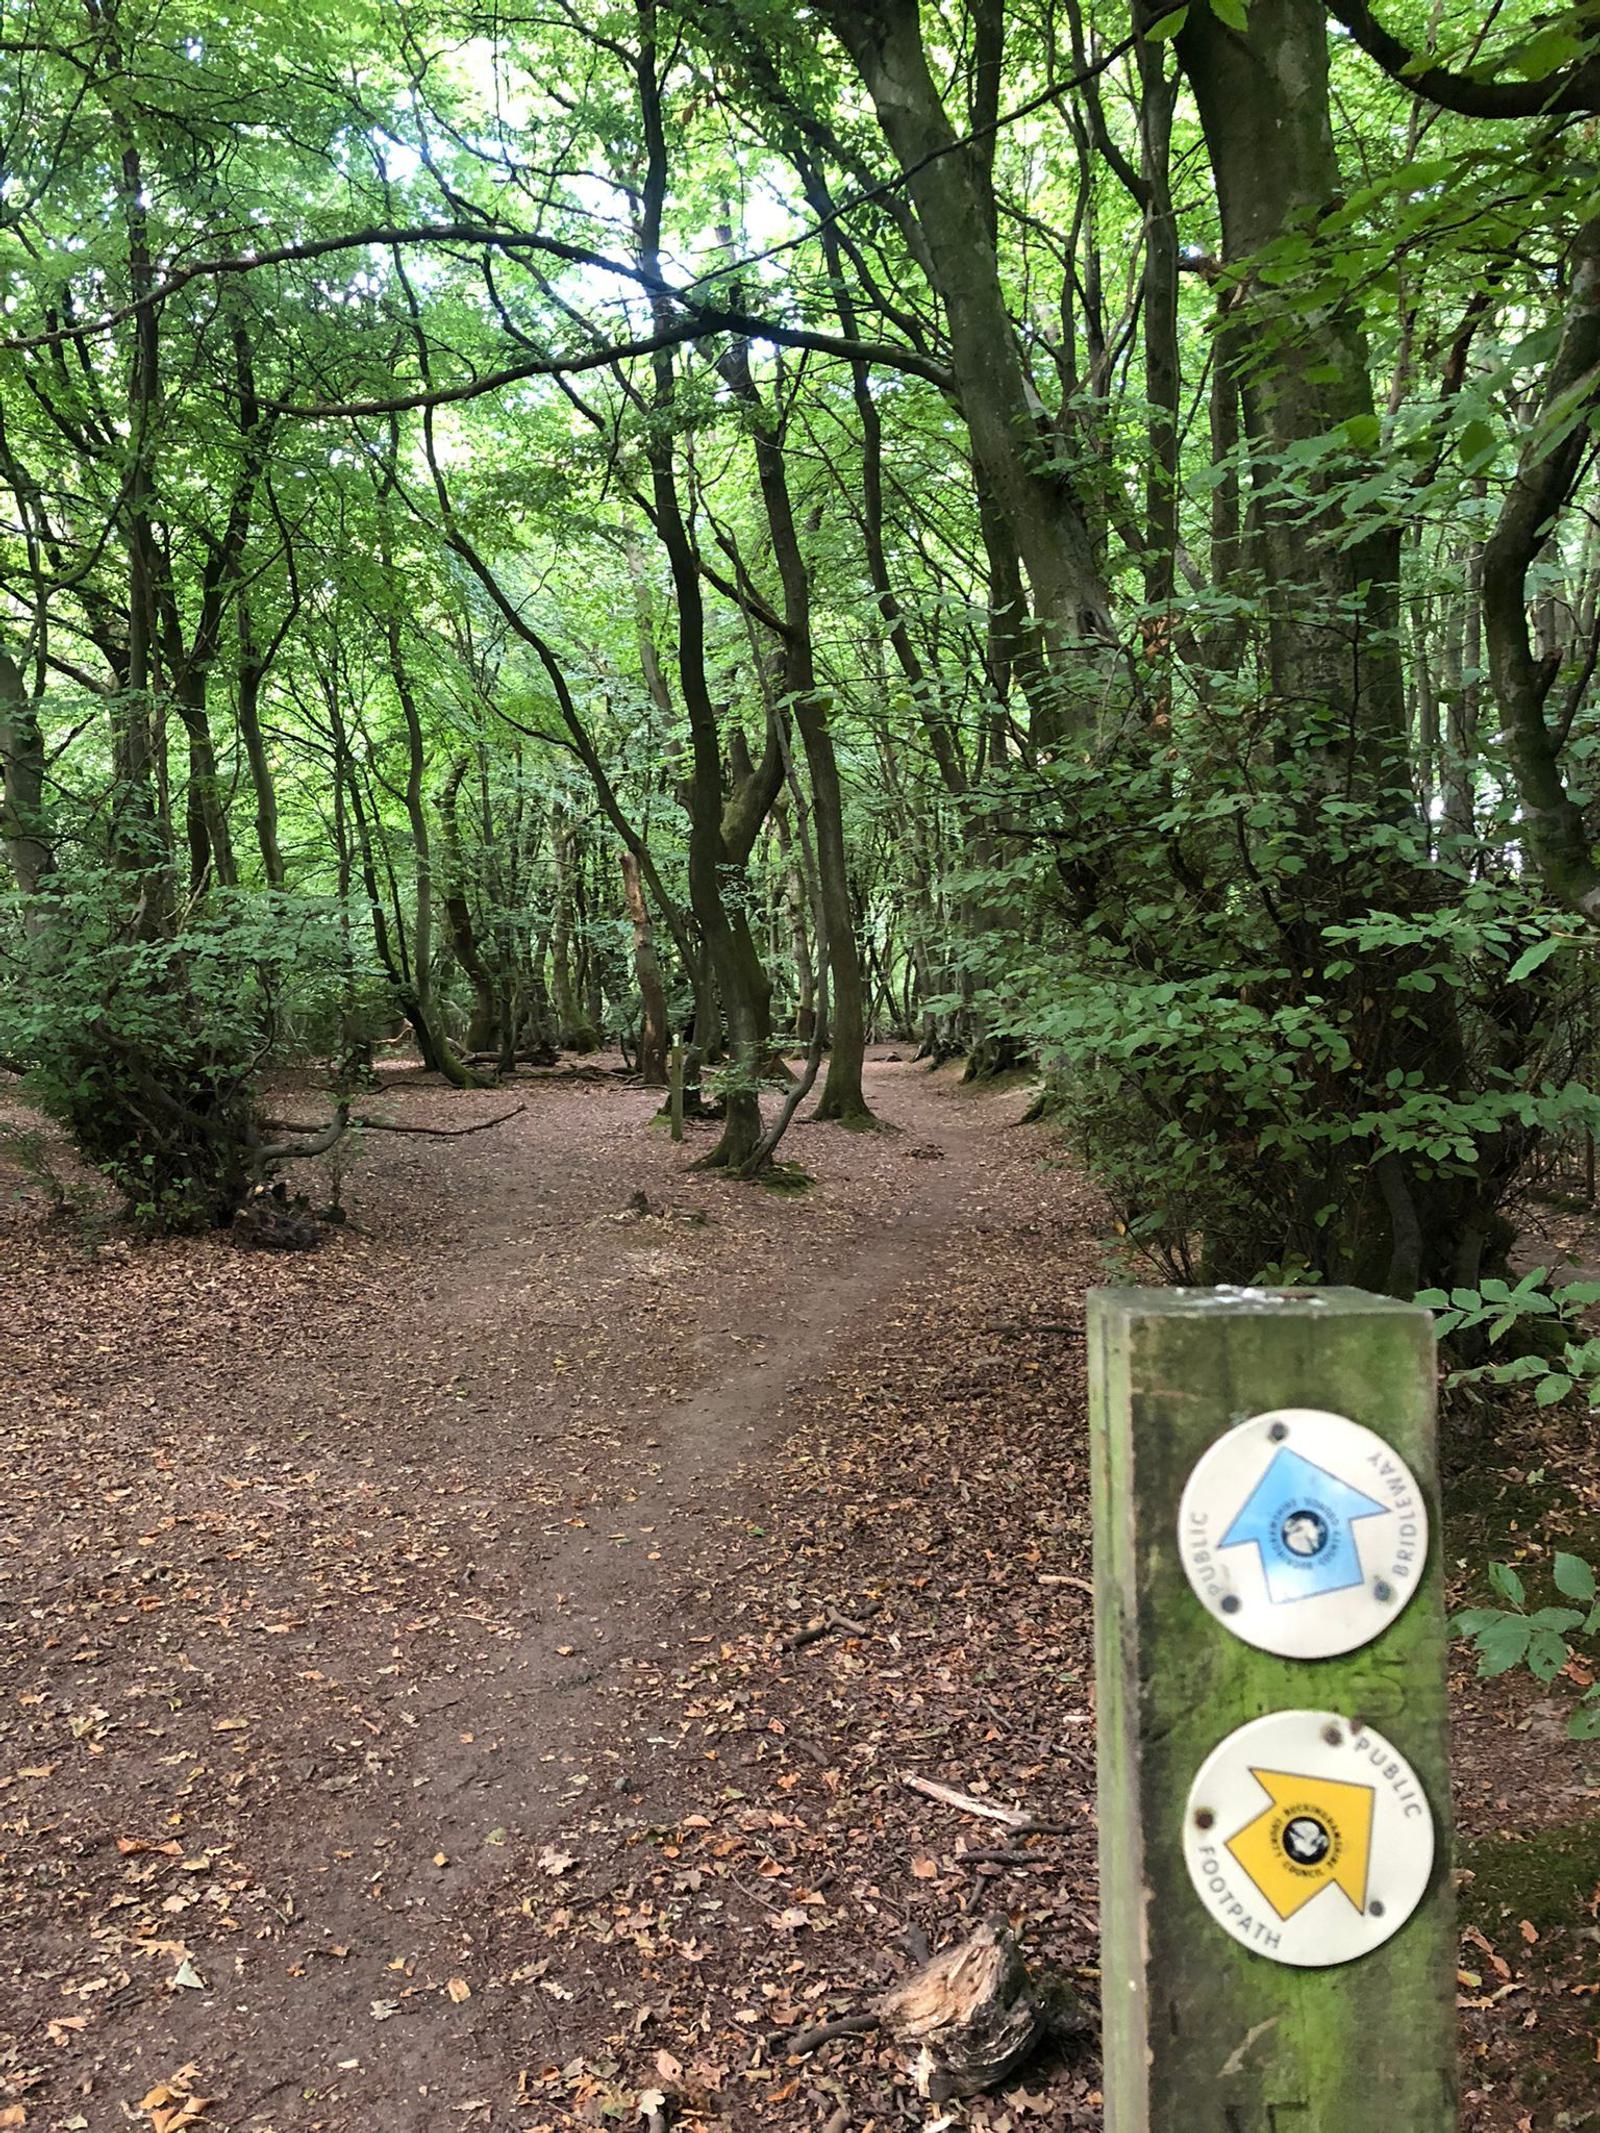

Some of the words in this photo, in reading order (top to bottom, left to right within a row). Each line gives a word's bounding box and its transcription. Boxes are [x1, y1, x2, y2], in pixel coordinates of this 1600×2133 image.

[1190, 1511, 1219, 1597] PUBLIC
[1367, 1452, 1417, 1577] BRIDLEWAY
[1355, 1738, 1422, 1818] PUBLIC
[1199, 1846, 1282, 1949] FOOTPATH
